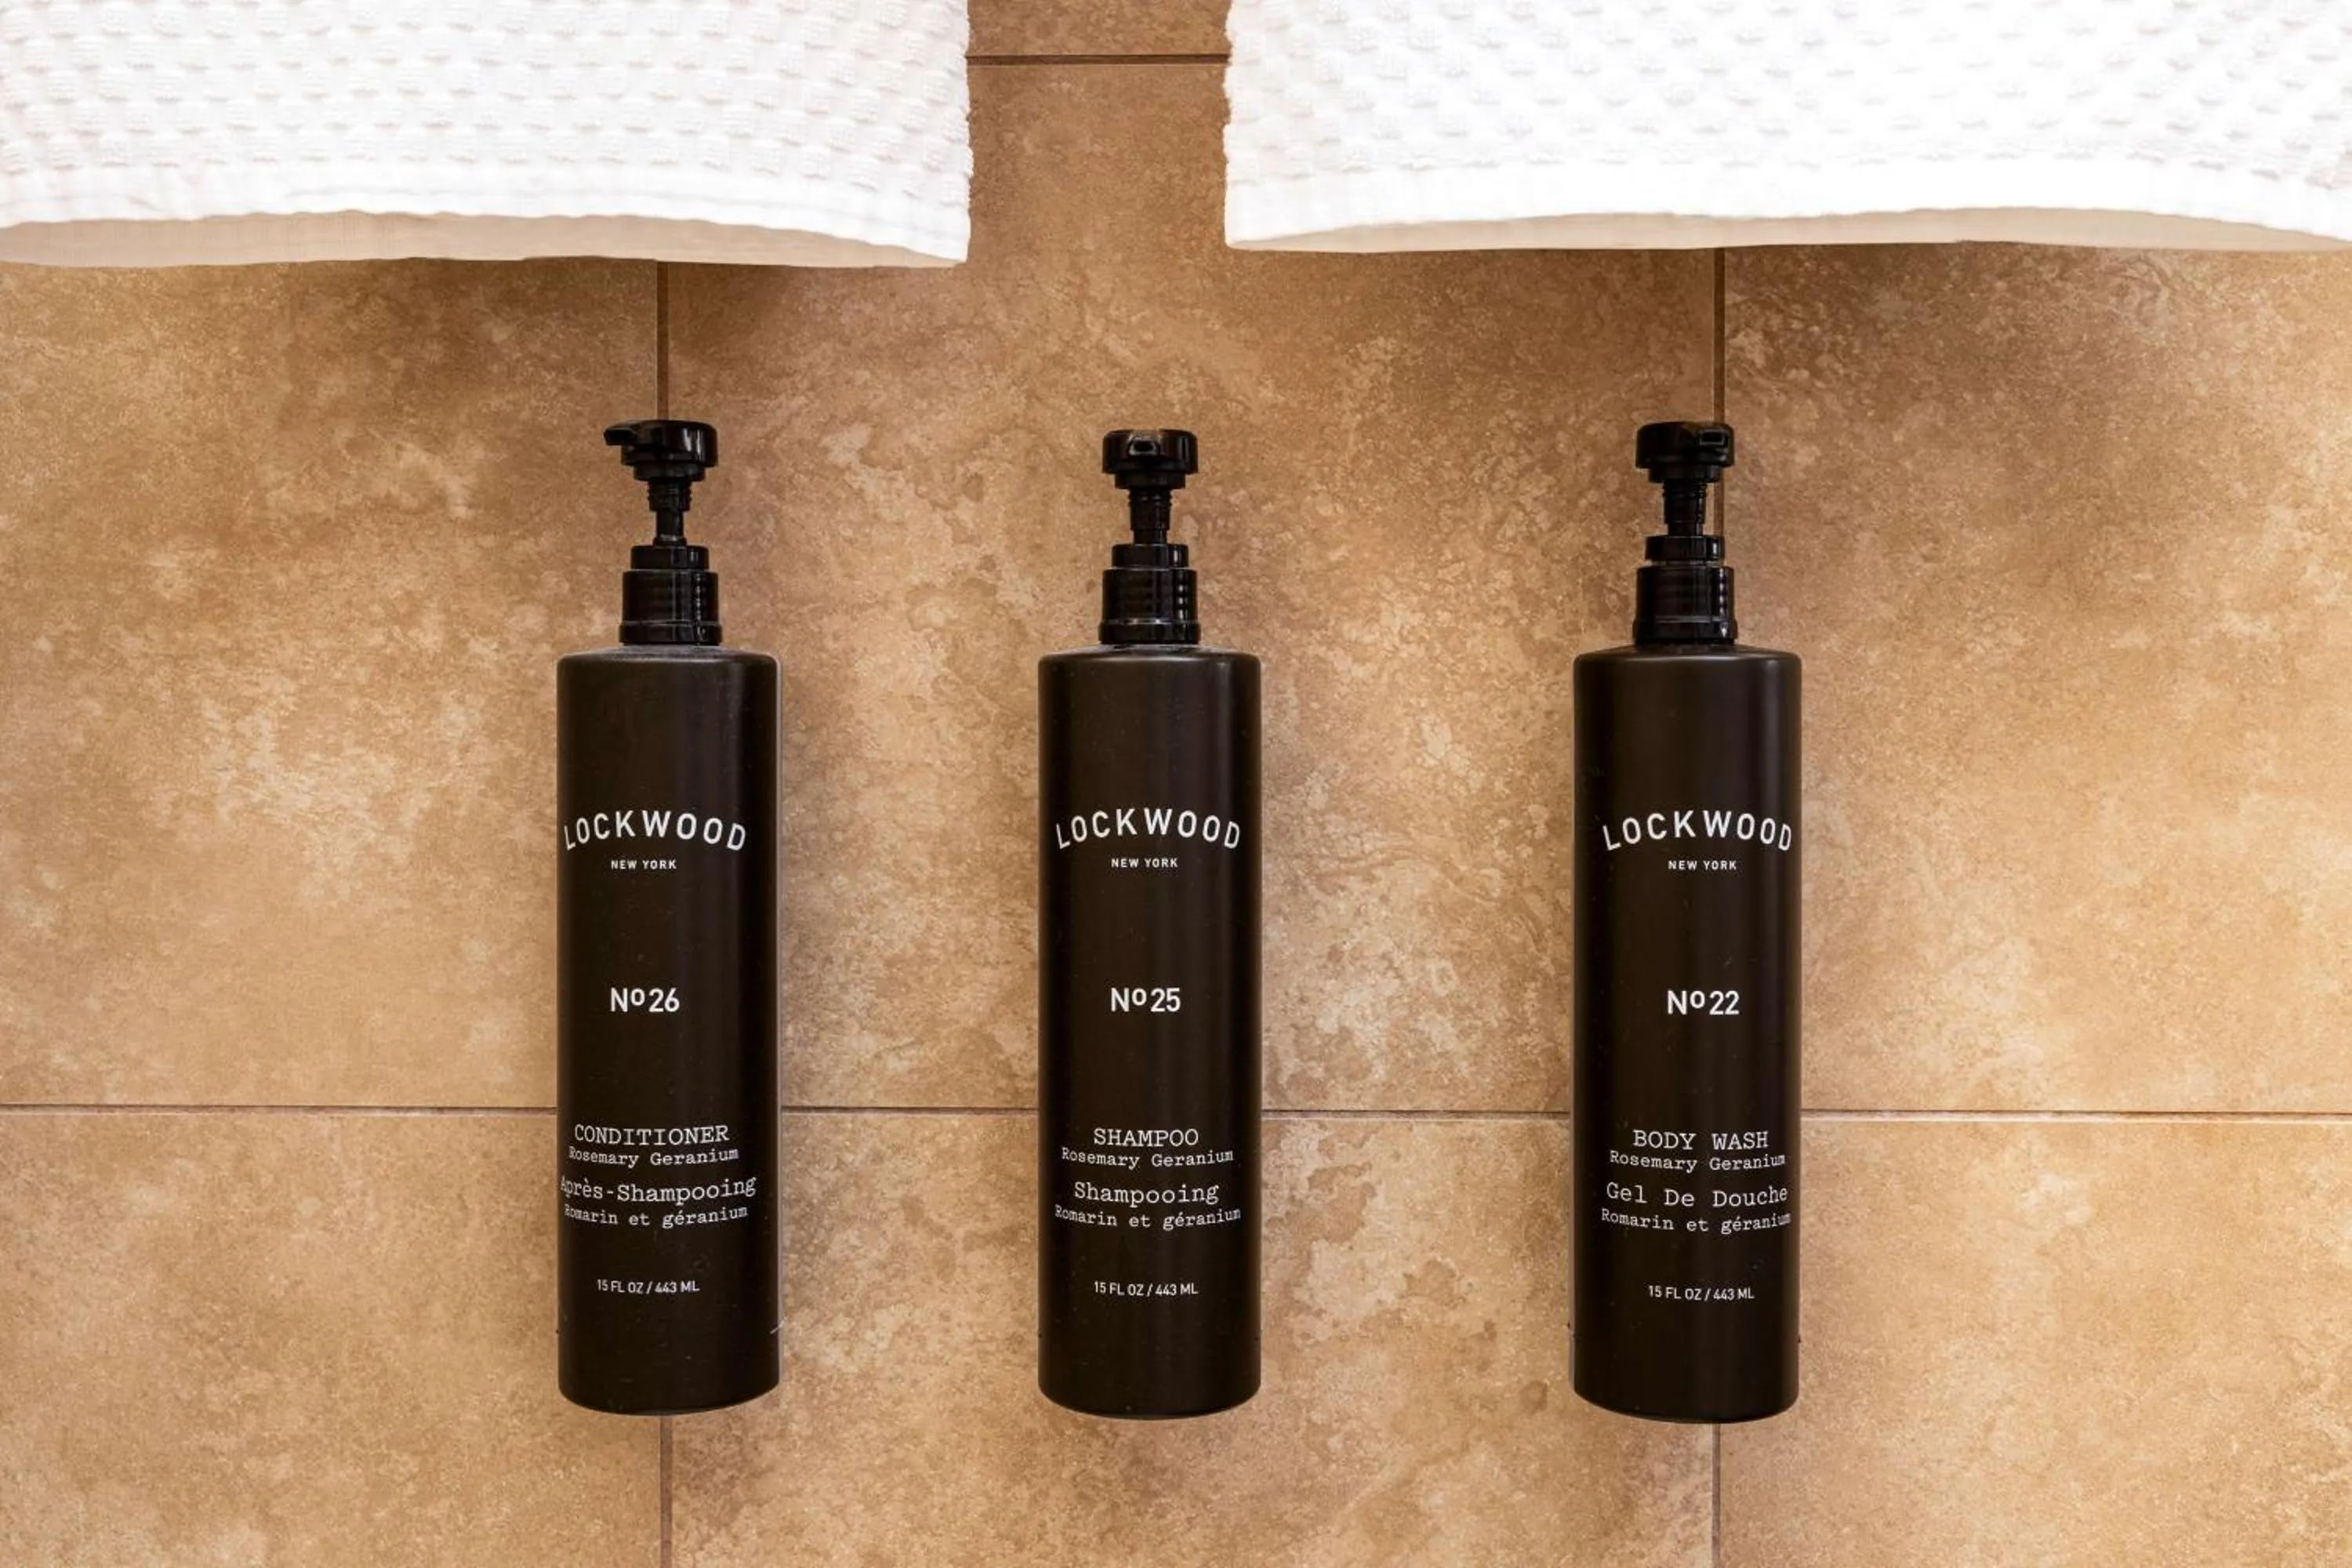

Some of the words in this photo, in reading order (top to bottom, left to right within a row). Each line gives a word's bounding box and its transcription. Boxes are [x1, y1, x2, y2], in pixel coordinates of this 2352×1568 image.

[564, 810, 746, 851] LOCKWOOD
[1056, 808, 1240, 849] LOCKWOOD
[1602, 810, 1792, 851] LOCKWOOD
[611, 859, 637, 869] NEW
[642, 859, 677, 869] YORK
[1111, 858, 1139, 868] NEW
[1144, 858, 1178, 868] YORK
[1668, 860, 1697, 870] NEW
[1703, 860, 1737, 870] YORK
[575, 1123, 730, 1146] CONDITIONER
[1094, 1127, 1199, 1147] SHAMPOO
[1633, 1129, 1697, 1150] BODY
[1711, 1131, 1769, 1151] WASH
[568, 1145, 639, 1169] Rosemary
[650, 1148, 739, 1166] Geranium
[1062, 1147, 1140, 1171] Rosemary
[1151, 1149, 1234, 1167] Geranium
[1610, 1150, 1697, 1174] Rosemary
[1709, 1153, 1786, 1171] Geranium
[561, 1175, 757, 1206] Après-Shampooing
[1074, 1181, 1220, 1208] Shampooing
[1606, 1182, 1647, 1203] Gel
[1664, 1189, 1696, 1207] De
[1712, 1186, 1788, 1207] Douche
[564, 1204, 618, 1225] Romarin
[628, 1213, 651, 1226] et
[662, 1207, 749, 1229] géranium
[1054, 1204, 1117, 1227] Romarin
[1129, 1215, 1151, 1228] et
[1163, 1208, 1241, 1231] géranium
[1602, 1208, 1675, 1230] Romarin
[1686, 1218, 1709, 1232] et
[1721, 1213, 1791, 1235] géranium
[597, 1279, 609, 1291] 15
[611, 1280, 625, 1294] FL
[628, 1282, 644, 1294] OZ
[655, 1282, 677, 1294] 443
[681, 1280, 699, 1293] ML
[1094, 1280, 1107, 1294] 15
[1109, 1283, 1125, 1295] FL
[1127, 1284, 1144, 1296] OZ
[1155, 1283, 1178, 1296] 443
[1180, 1282, 1199, 1294] ML
[1649, 1285, 1662, 1298] 15
[1665, 1287, 1681, 1299] FL
[1685, 1288, 1703, 1301] OZ
[1713, 1288, 1735, 1301] 443
[1737, 1287, 1755, 1299] ML
